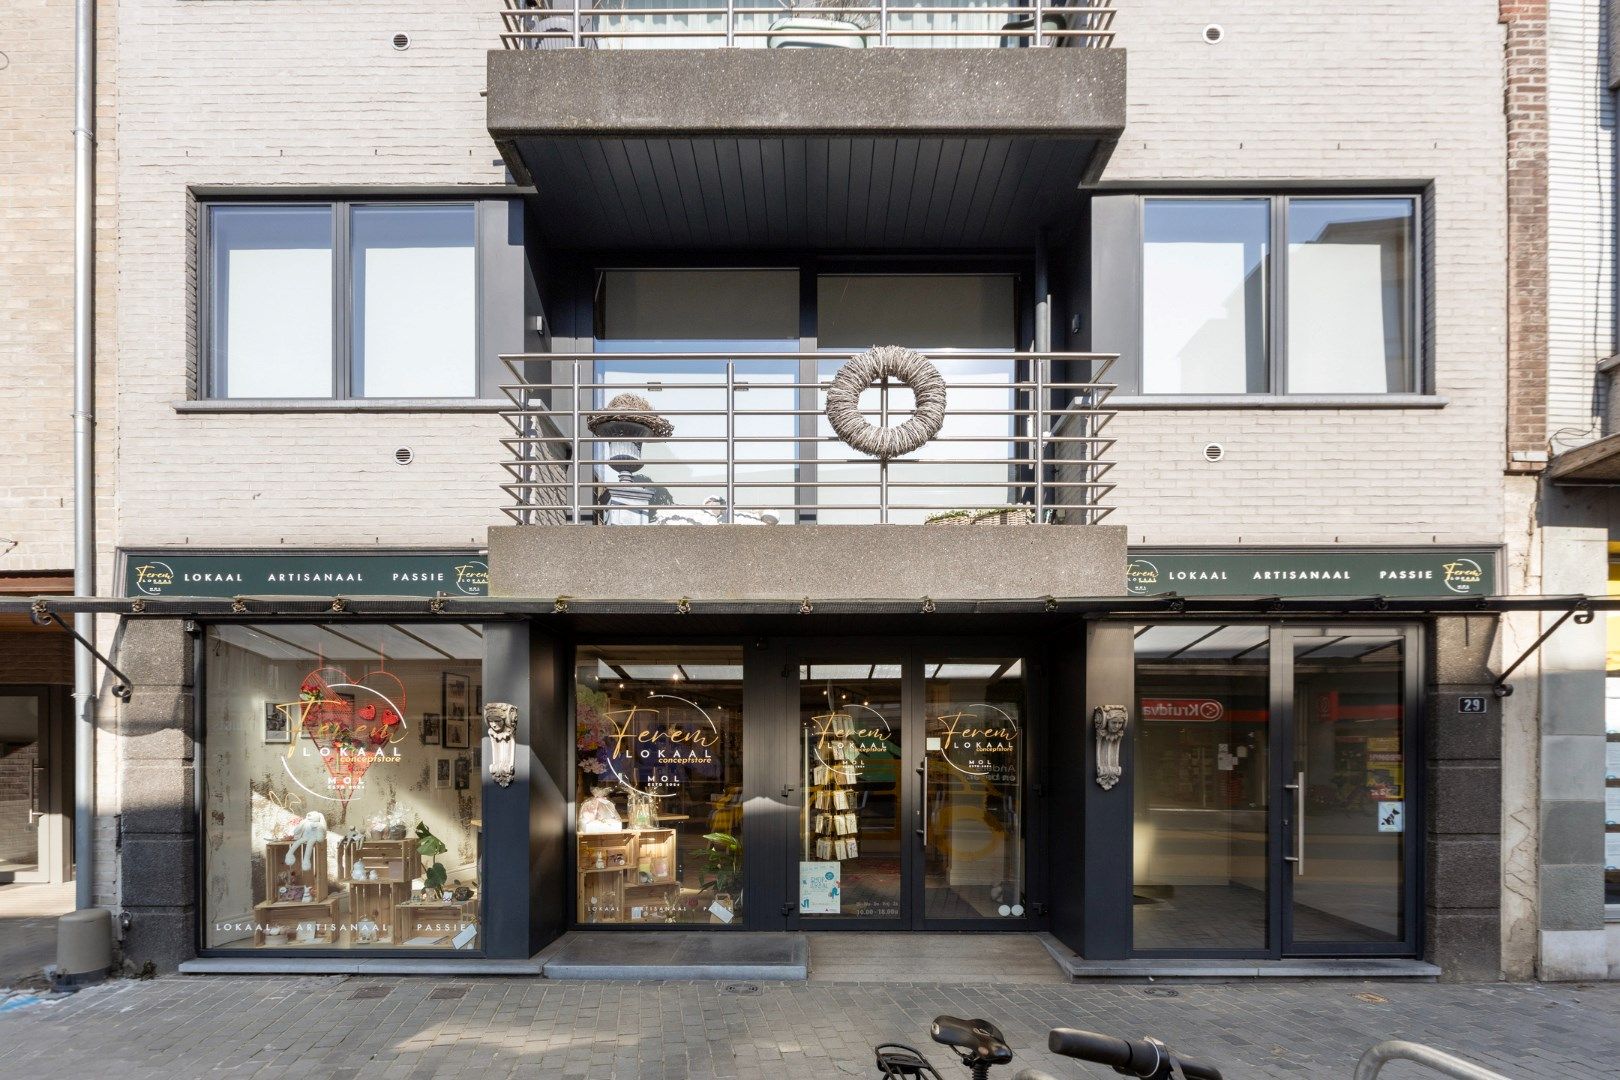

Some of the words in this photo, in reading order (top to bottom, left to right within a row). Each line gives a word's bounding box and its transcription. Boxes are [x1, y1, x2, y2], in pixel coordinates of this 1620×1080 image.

[184, 573, 242, 582] LOKAAL
[268, 573, 362, 582] ARTISANAAL
[392, 573, 444, 581] PASSIE
[1169, 571, 1227, 580] LOKAAL
[1253, 571, 1350, 580] ARTISANAAL
[1380, 570, 1433, 579] PASSIE
[1464, 699, 1480, 712] 29
[302, 747, 401, 757] LOKAAL
[626, 750, 712, 758] LOKAAL
[340, 756, 401, 764] conceptstore
